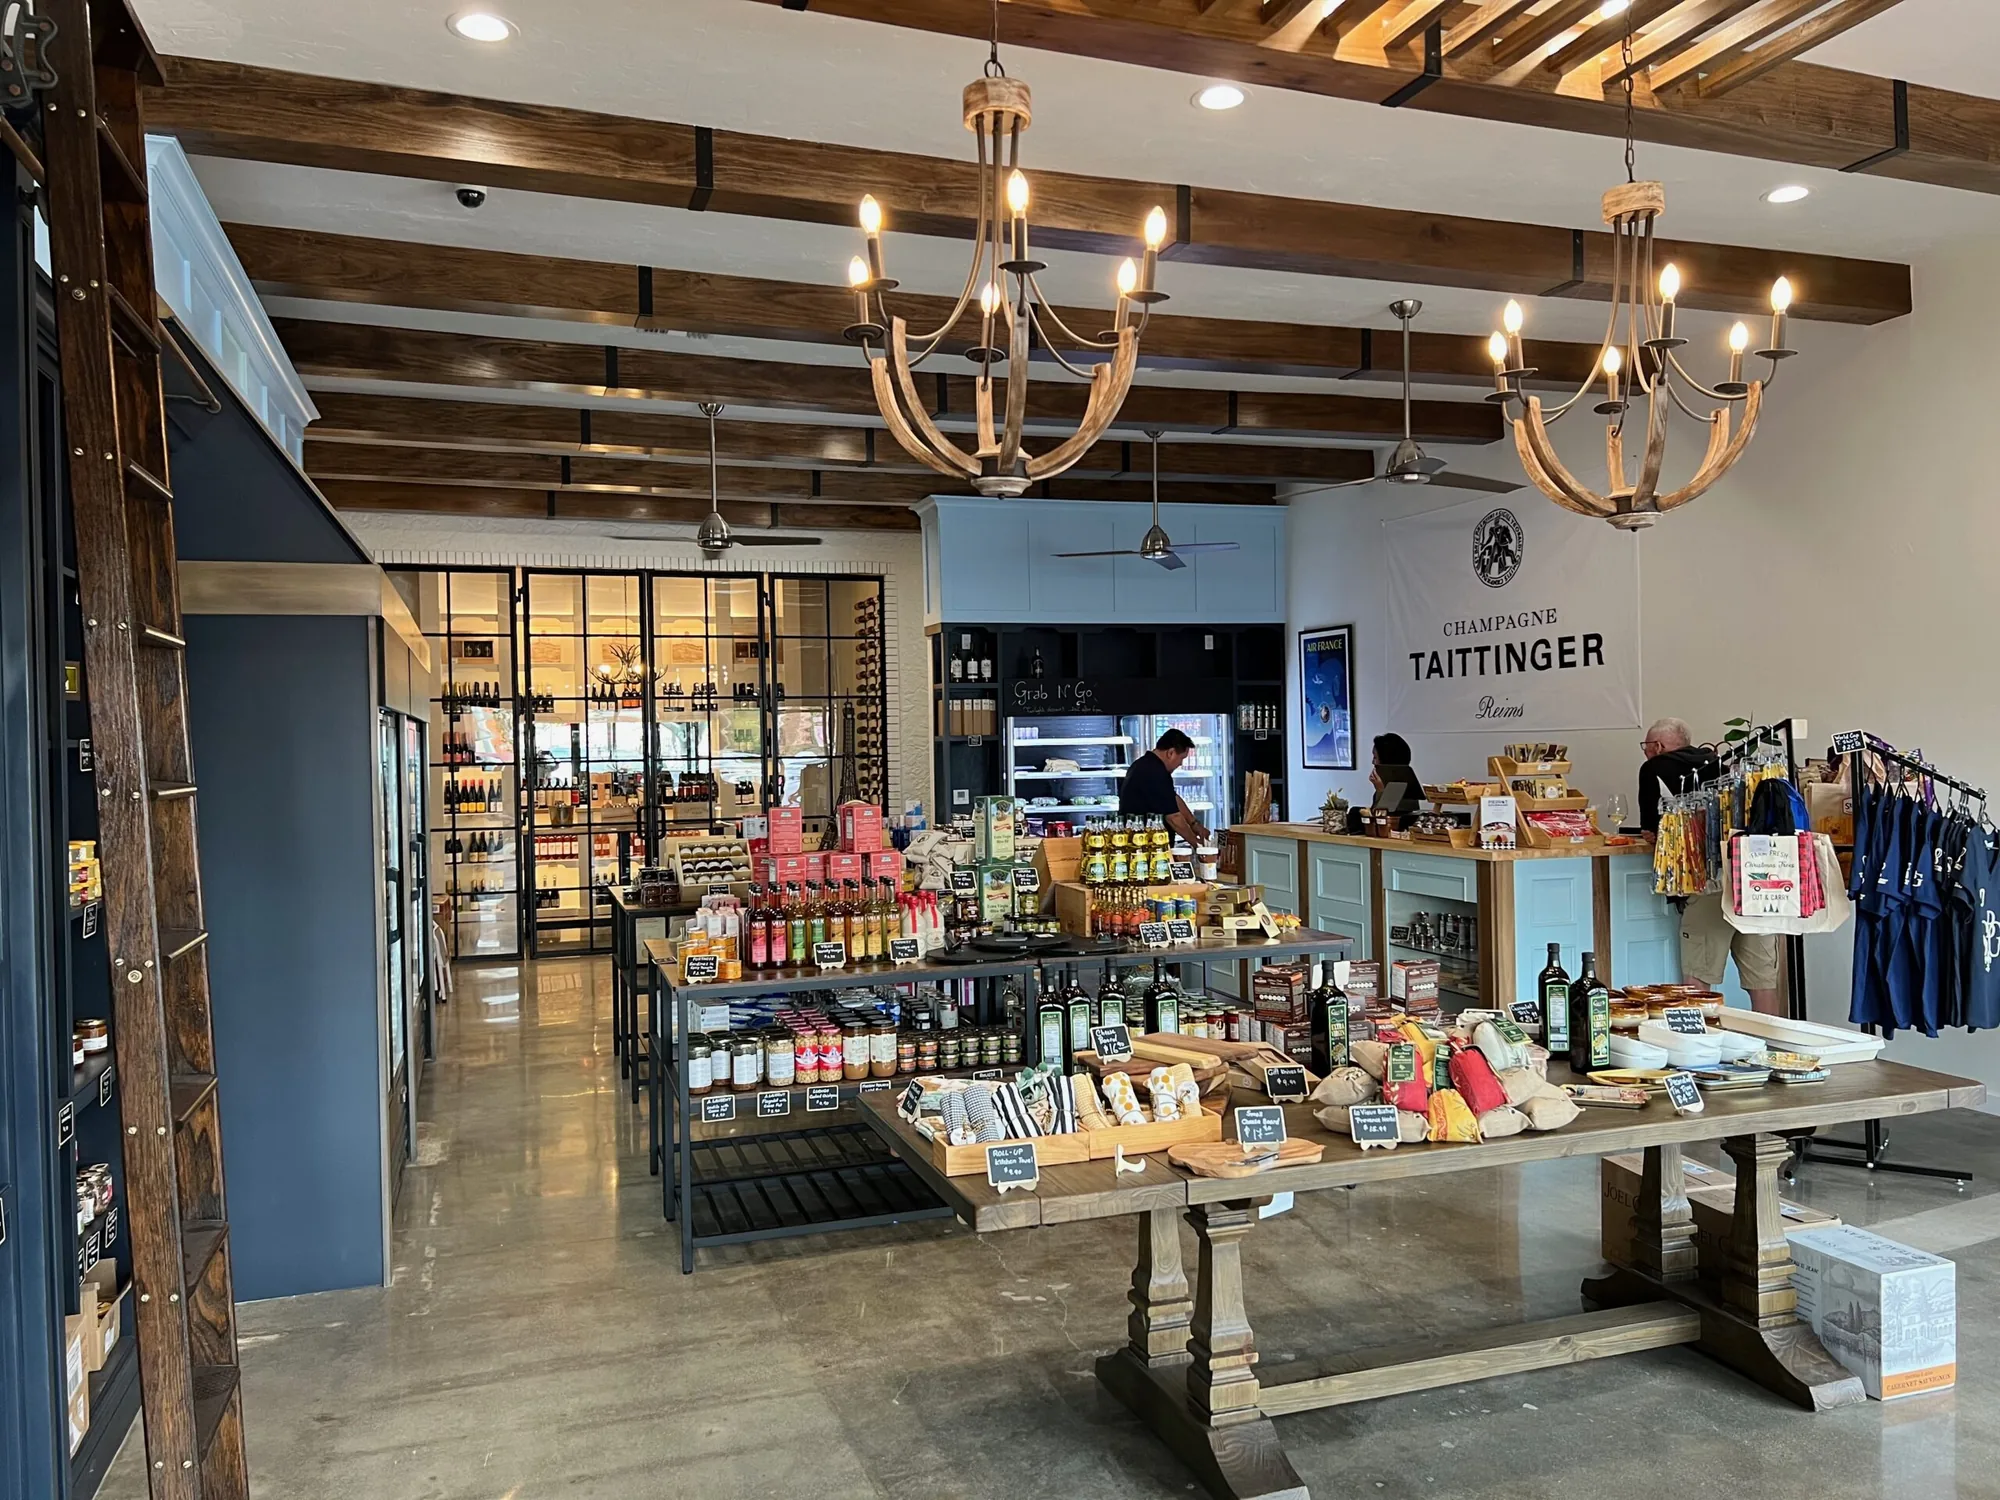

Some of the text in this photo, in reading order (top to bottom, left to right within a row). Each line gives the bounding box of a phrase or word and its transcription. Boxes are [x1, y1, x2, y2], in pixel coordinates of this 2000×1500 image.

[1443, 608, 1558, 637] CHAMPAGNE
[1307, 639, 1343, 652] AIR FRANCE
[1409, 632, 1605, 681] TAITTINGER
[1015, 681, 1048, 705] Grab
[1075, 681, 1093, 705] Go
[1475, 695, 1524, 720] Reims
[1744, 861, 1795, 869] Christmas Trees
[1769, 850, 1789, 858] FRESH
[992, 1148, 1024, 1157] ROLL-UP
[1604, 1181, 1632, 1208] JOEL
